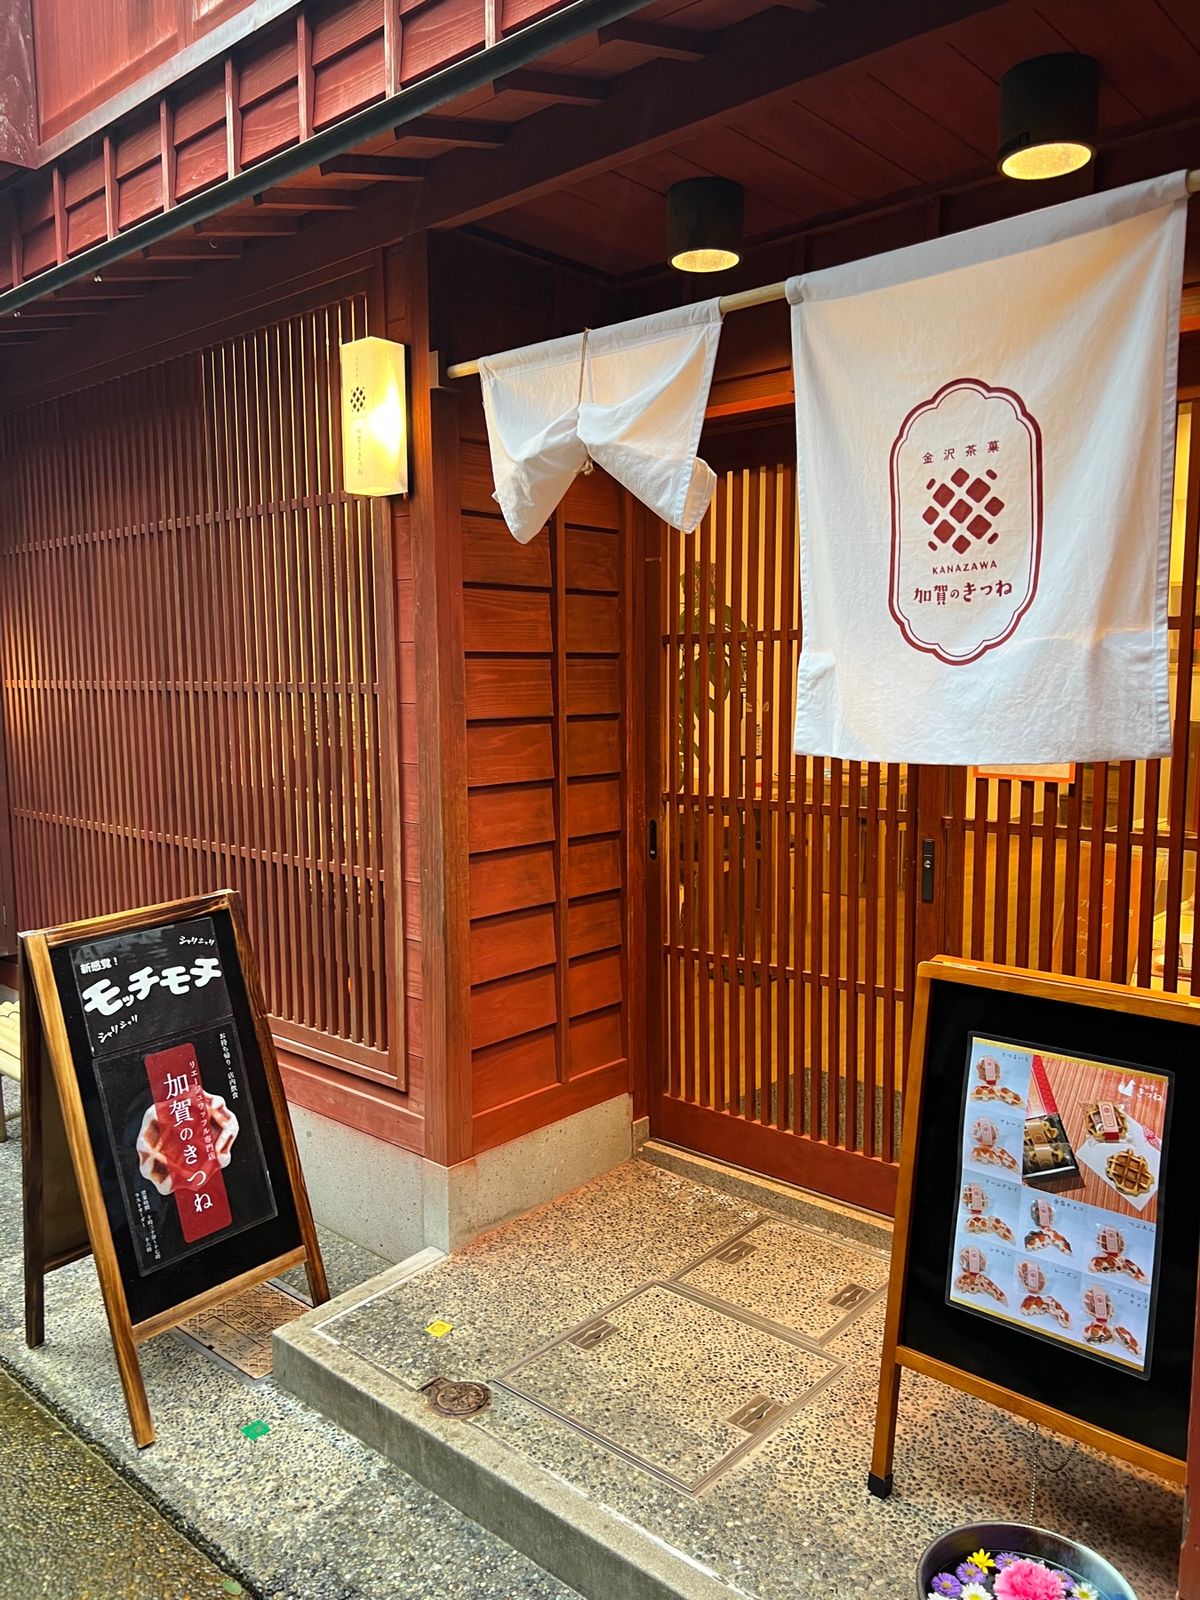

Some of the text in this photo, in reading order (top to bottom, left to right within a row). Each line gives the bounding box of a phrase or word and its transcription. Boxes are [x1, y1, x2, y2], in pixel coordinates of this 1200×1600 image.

[921, 440, 1001, 465] 金沢茶菓
[932, 560, 998, 575] KANAZAWA
[913, 580, 1013, 605] 加賀のきつね
[82, 958, 222, 1016] モッチモチ
[163, 1073, 213, 1213] 加賀のきつね
